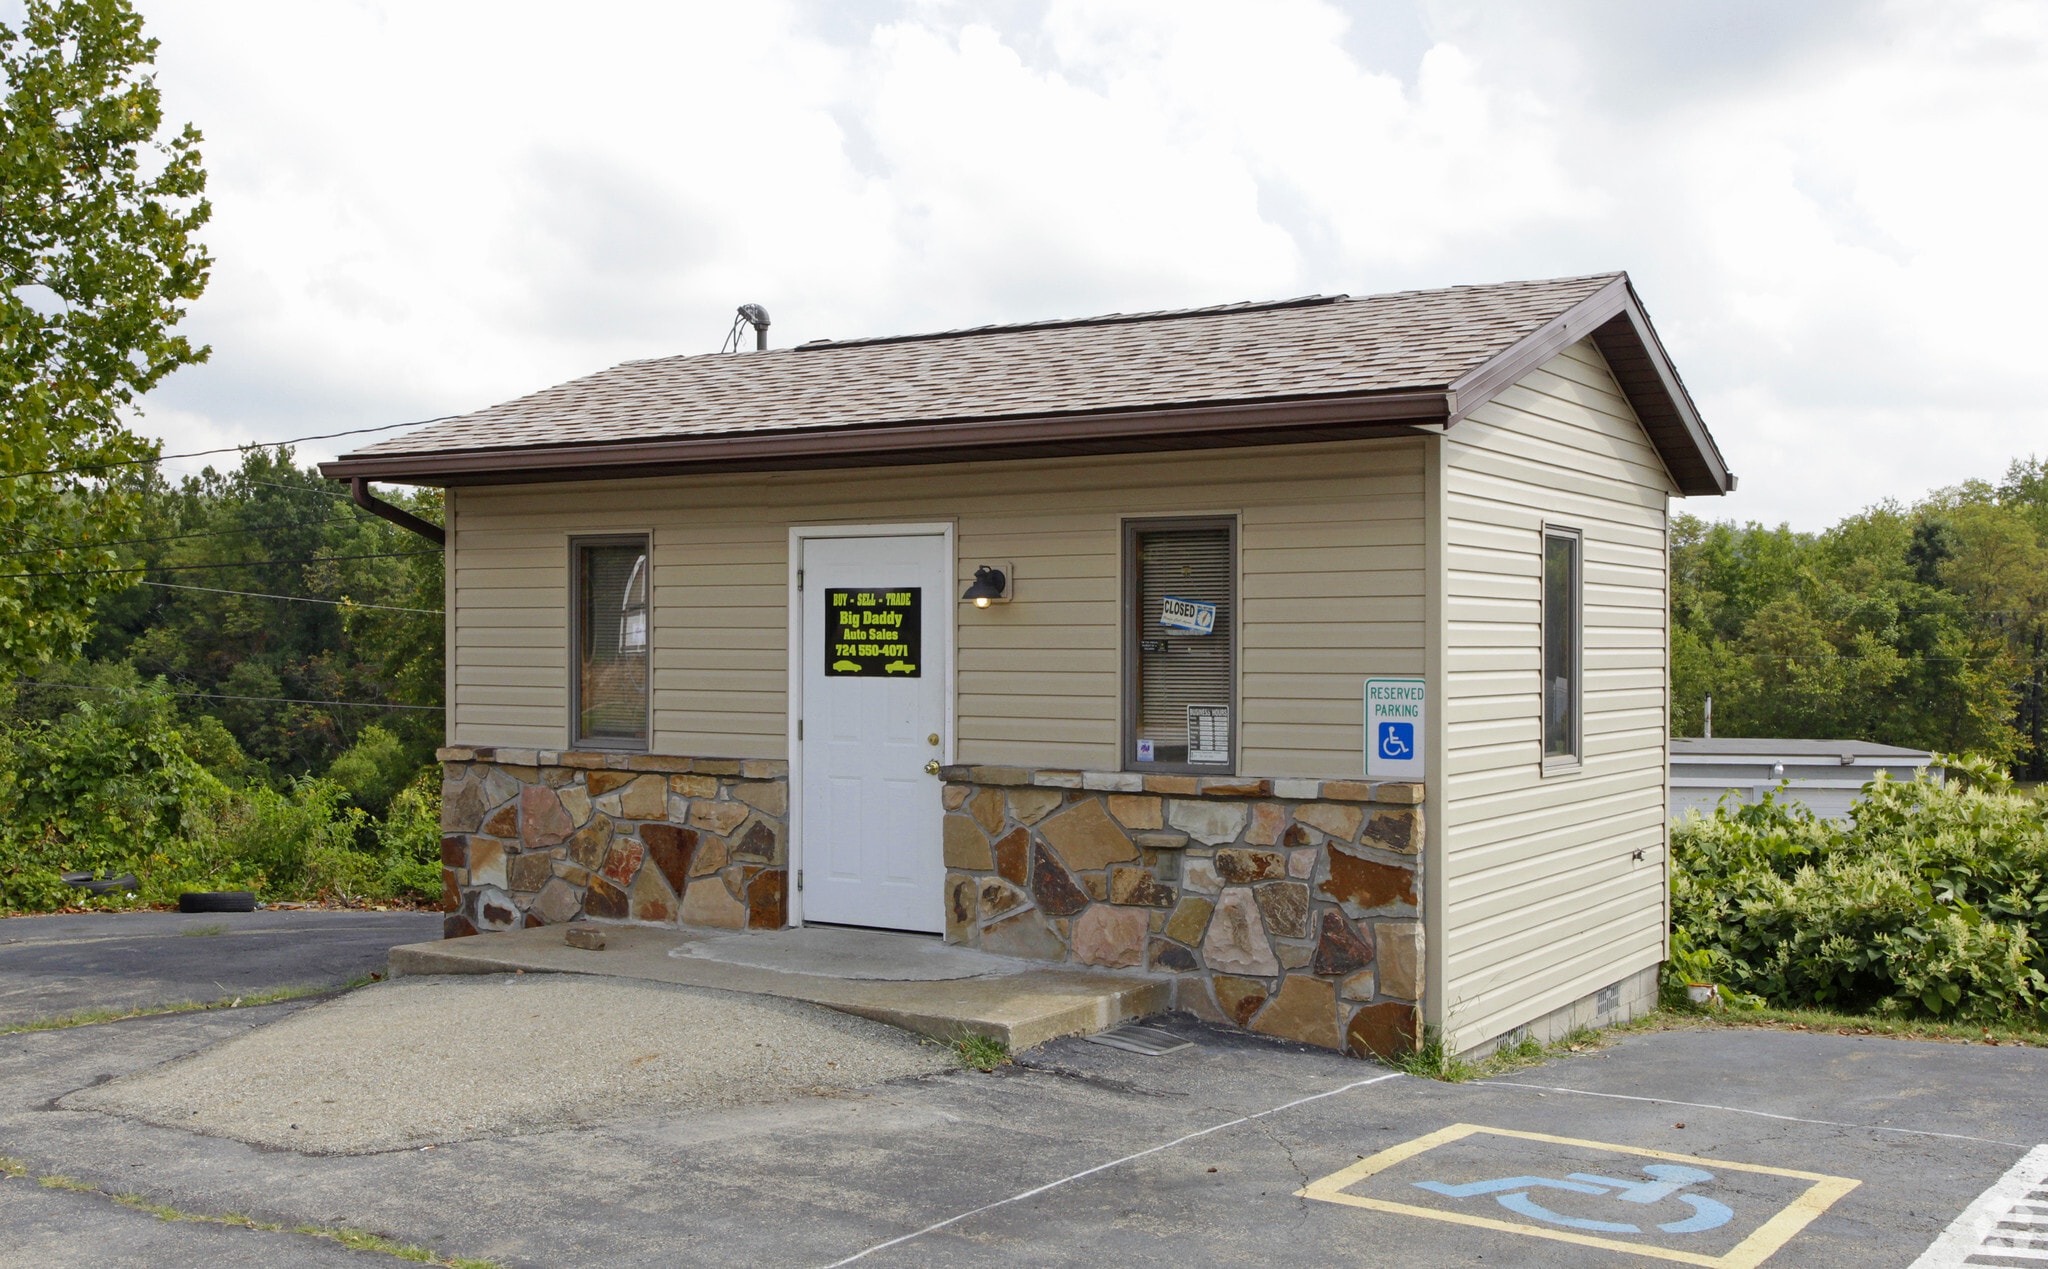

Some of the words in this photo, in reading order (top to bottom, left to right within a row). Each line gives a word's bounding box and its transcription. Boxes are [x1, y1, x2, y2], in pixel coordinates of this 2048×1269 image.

[833, 593, 848, 606] BUY
[857, 593, 876, 606] SELL
[885, 592, 911, 606] TRADE
[1164, 600, 1195, 618] CLOSED
[840, 611, 860, 628] Big
[863, 611, 903, 628] Daddy
[843, 628, 867, 640] Auto
[869, 628, 898, 640] Sales
[836, 644, 856, 656] 724
[858, 644, 908, 656] 550-4071
[1370, 686, 1424, 700] RESERVED
[1212, 708, 1229, 716] HOURS
[1375, 703, 1419, 717] PARKING
